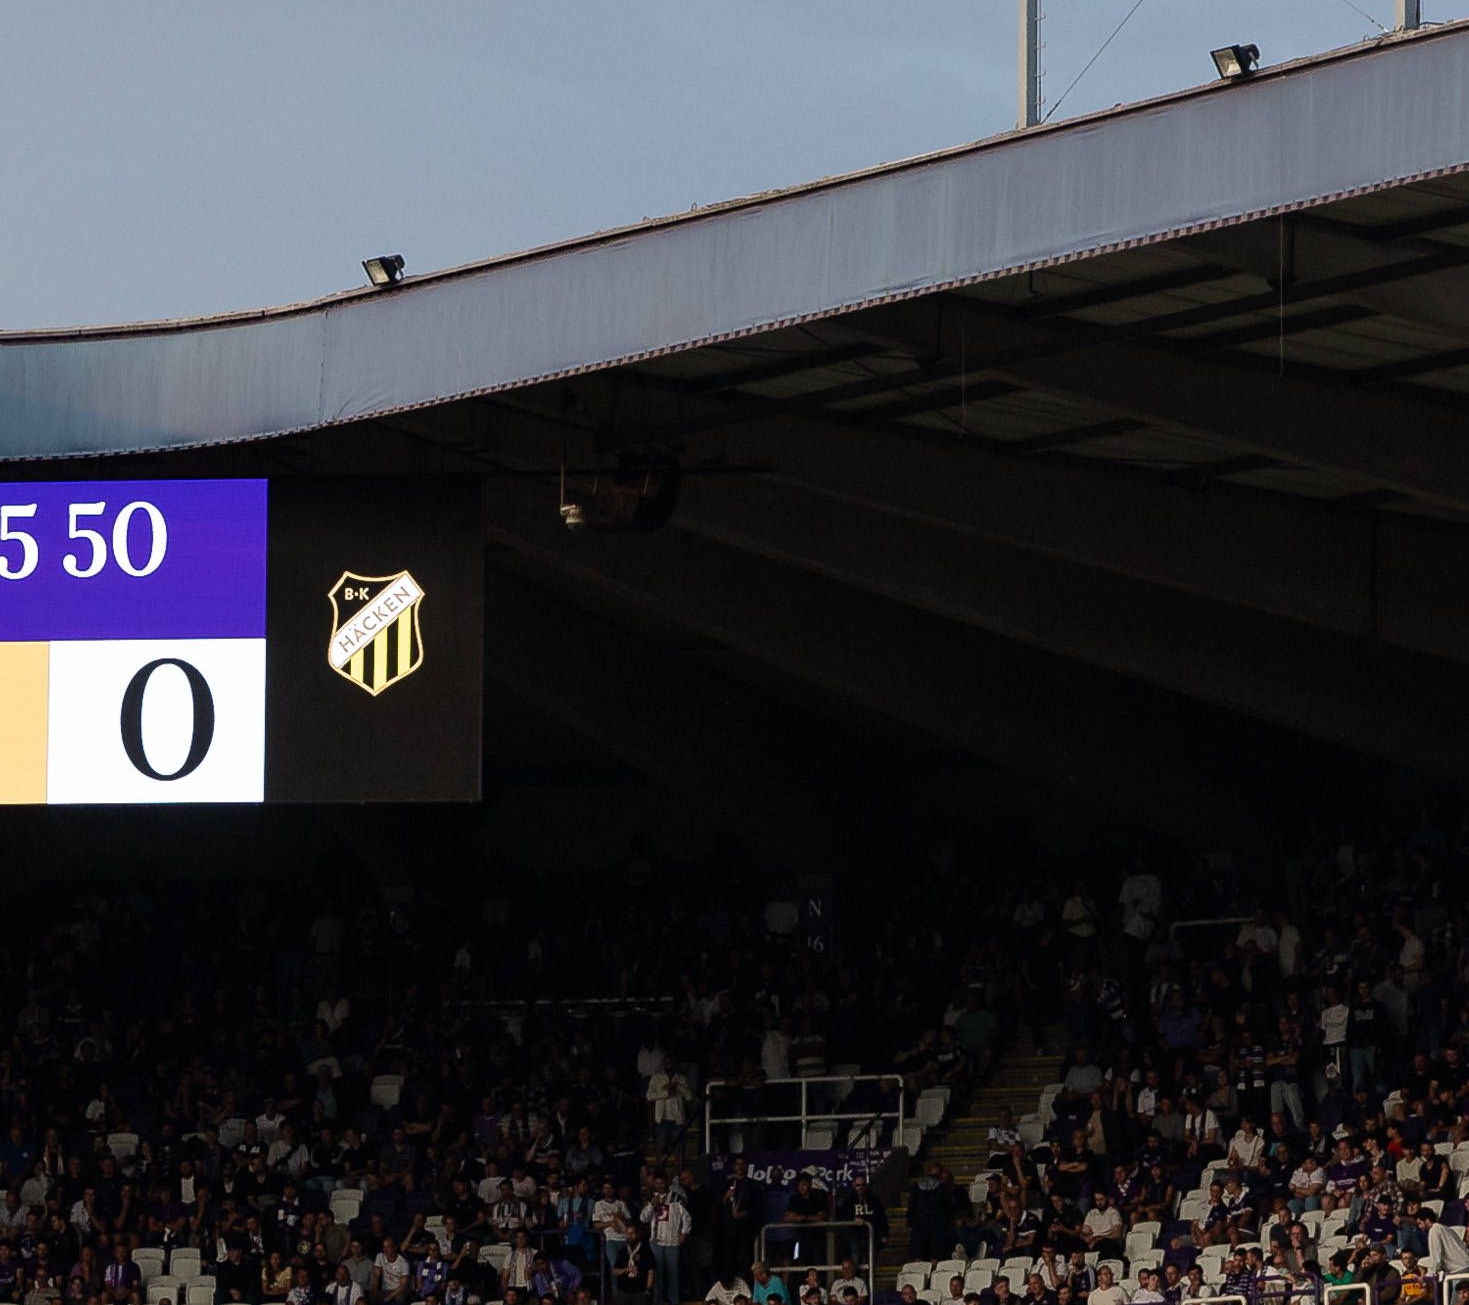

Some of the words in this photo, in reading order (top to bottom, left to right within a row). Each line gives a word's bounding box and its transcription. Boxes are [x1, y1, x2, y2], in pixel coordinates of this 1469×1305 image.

[62, 500, 168, 579] 50
[339, 586, 411, 653] HÄCKEN
[120, 657, 215, 782] 0
[808, 899, 822, 917] N
